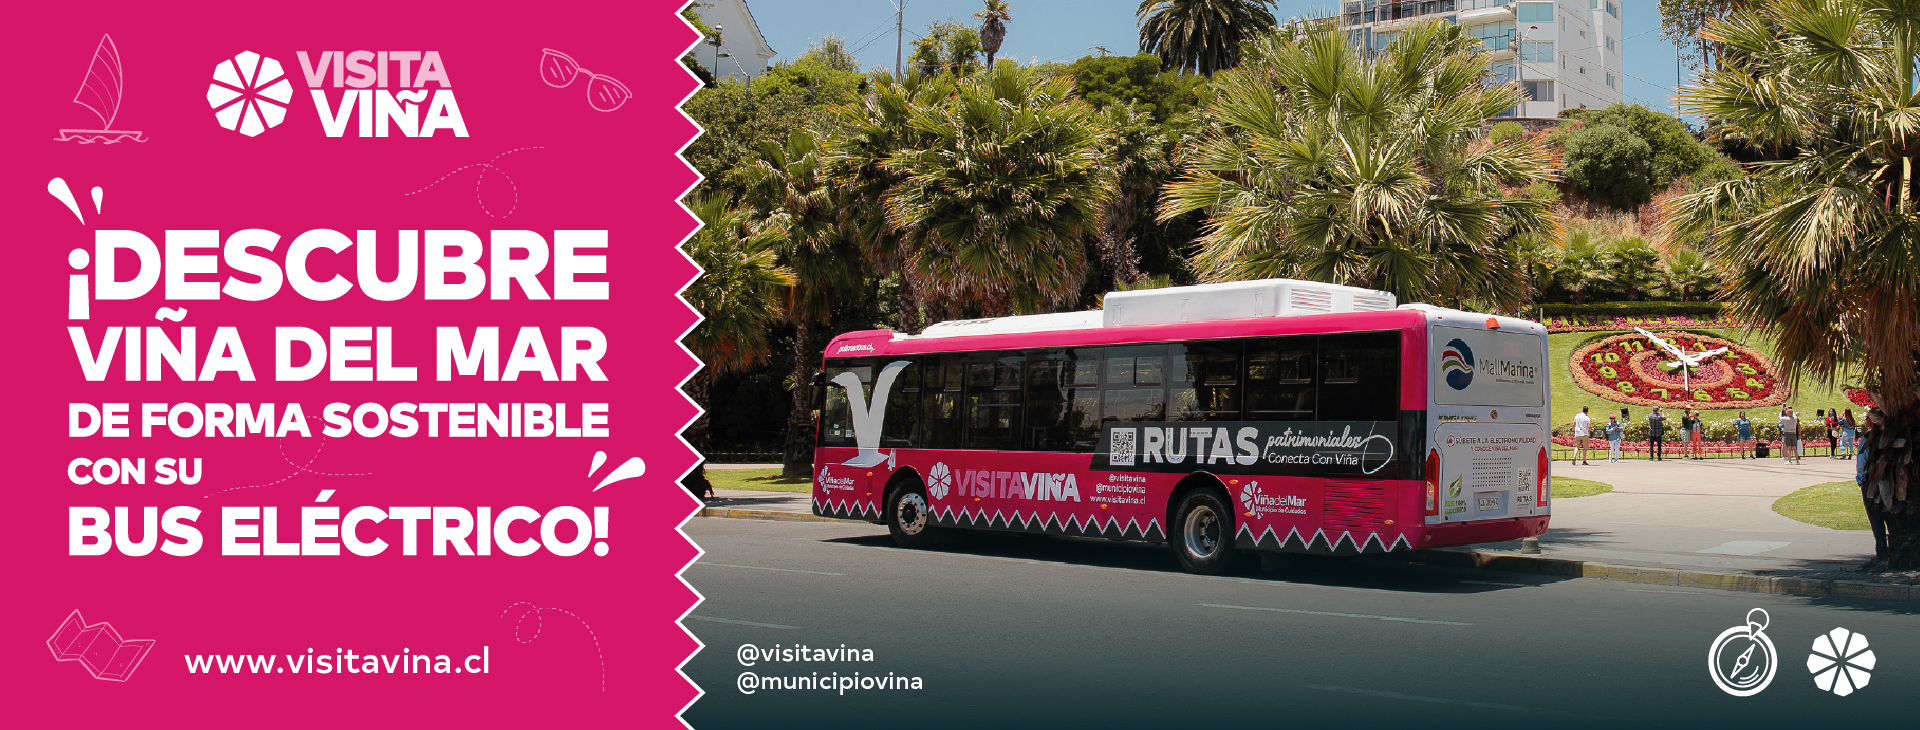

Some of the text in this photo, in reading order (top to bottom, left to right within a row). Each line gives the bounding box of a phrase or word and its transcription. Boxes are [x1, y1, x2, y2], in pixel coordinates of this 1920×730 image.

[1590, 352, 1620, 365] 10
[1599, 366, 1617, 379] 9
[1616, 381, 1636, 394] 8
[1651, 388, 1668, 399] 7
[1143, 424, 1366, 465] RUTAS patrimoniales
[1268, 453, 1358, 465] Conecta Con Viña
[1109, 474, 1146, 482] @visitavina
